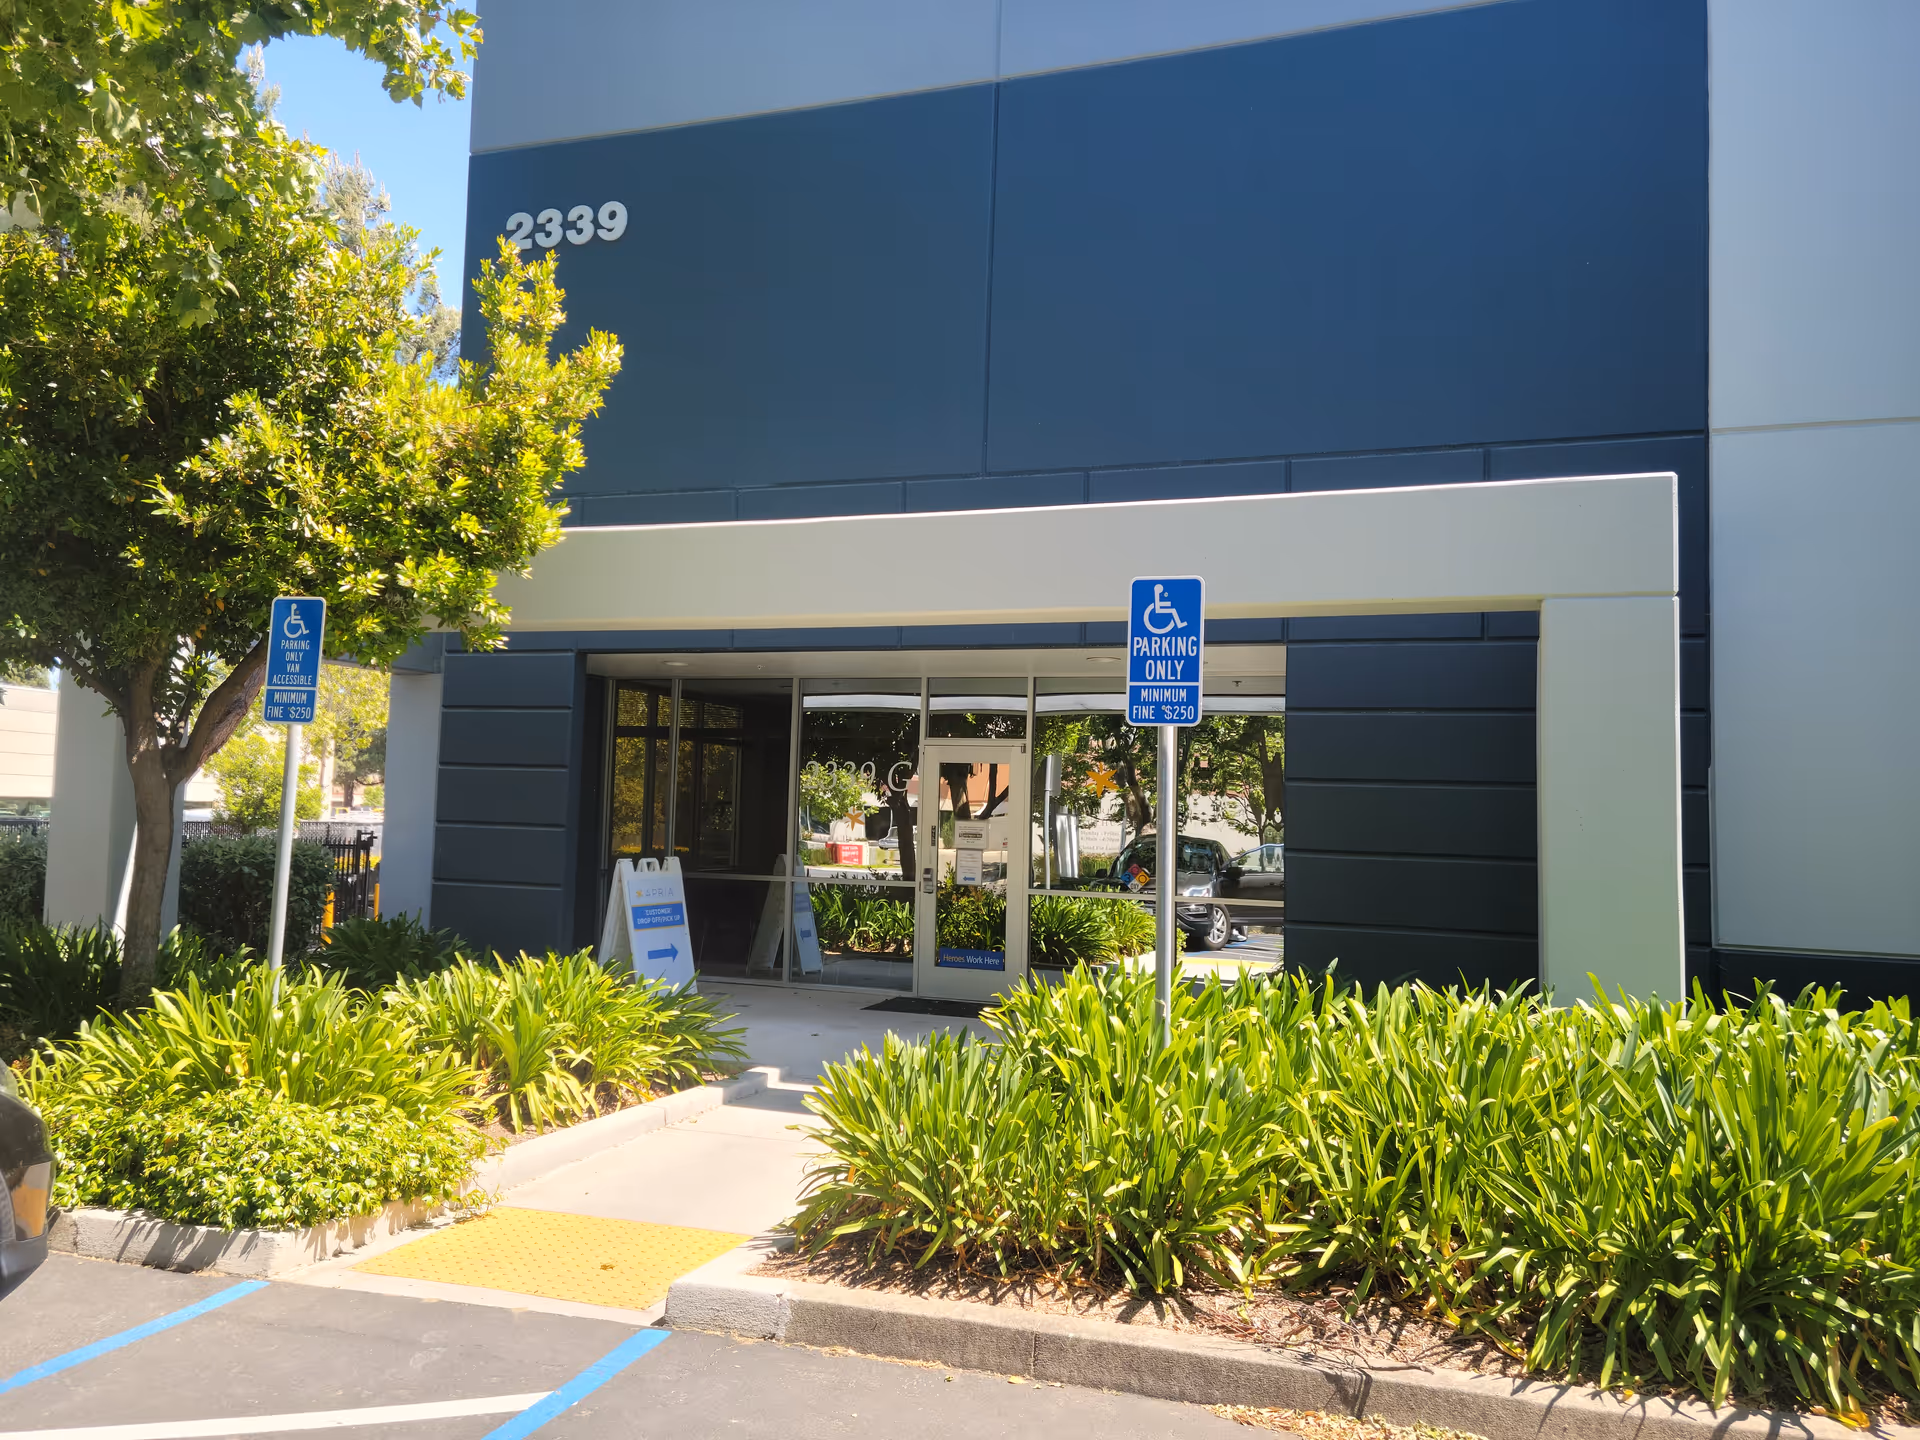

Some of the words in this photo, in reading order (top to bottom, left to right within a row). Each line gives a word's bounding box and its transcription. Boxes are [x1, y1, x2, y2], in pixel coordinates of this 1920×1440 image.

[505, 201, 628, 250] 2339
[280, 639, 310, 650] PARKING
[1133, 636, 1197, 657] PARKING
[285, 652, 303, 662] ONLY
[286, 663, 300, 673] VAN
[1145, 660, 1184, 680] ONLY
[272, 675, 313, 685] ACCESSIBLE
[273, 691, 308, 704] MINIMUM
[1140, 688, 1187, 702] MINIMUM
[267, 706, 284, 718] FINE
[289, 706, 312, 719] $250
[1132, 705, 1156, 719] FINE
[1164, 705, 1194, 720] $250
[803, 760, 877, 790] 2339
[887, 761, 912, 792] G
[943, 954, 965, 962] Heroes
[966, 955, 983, 964] Work
[984, 956, 1000, 965] Here
